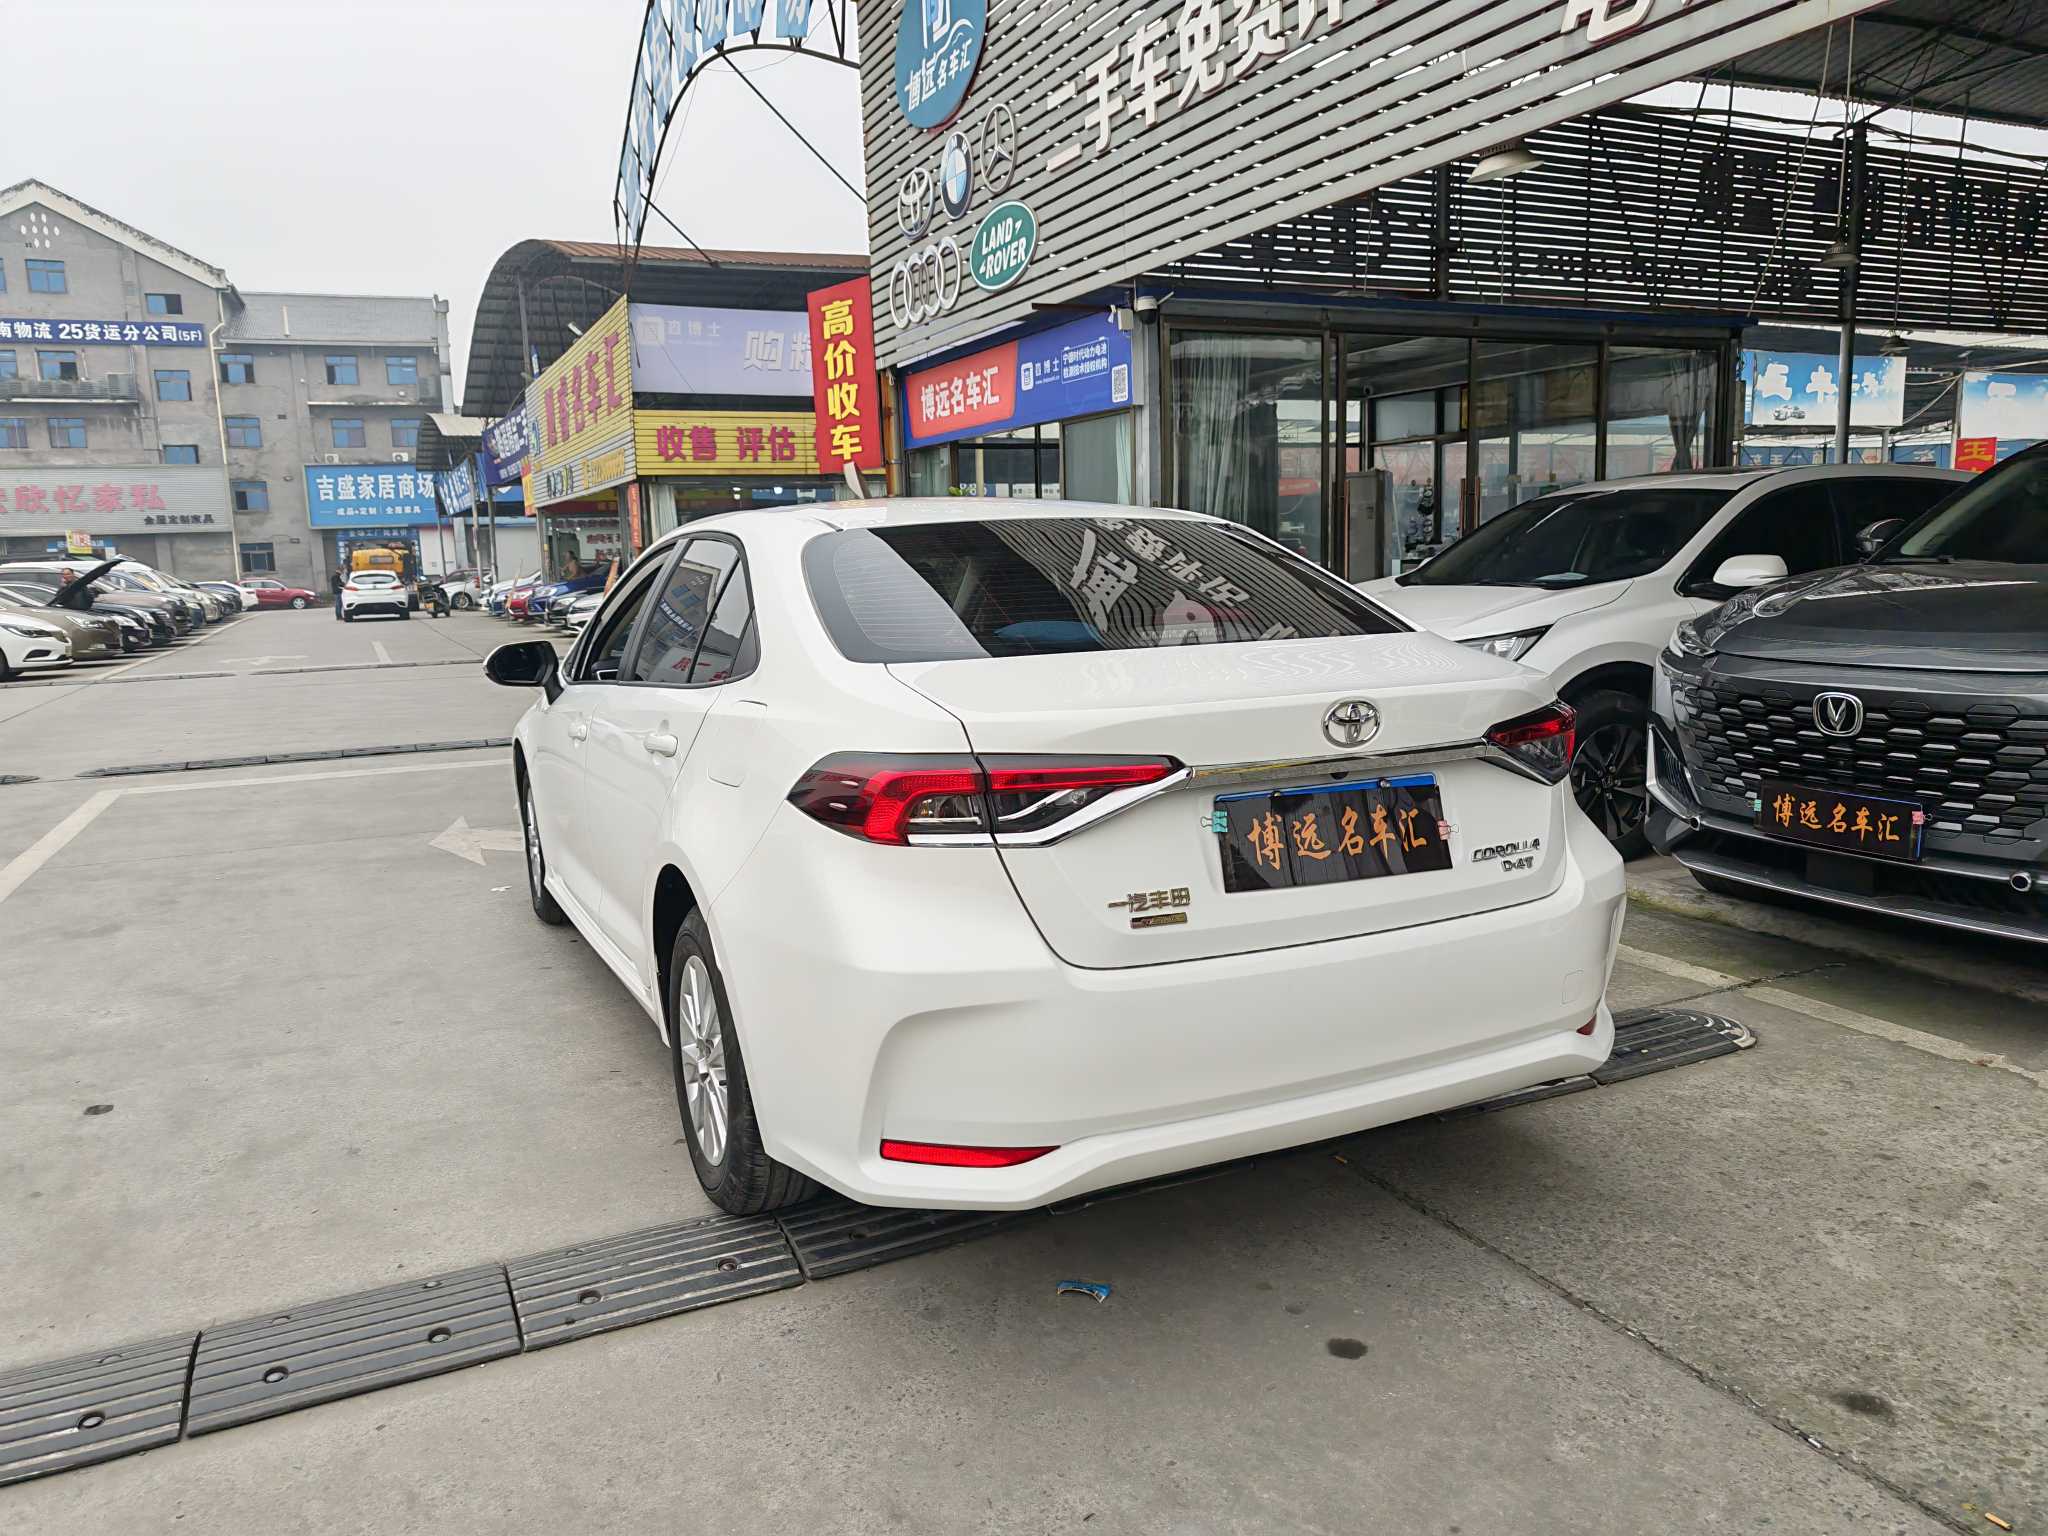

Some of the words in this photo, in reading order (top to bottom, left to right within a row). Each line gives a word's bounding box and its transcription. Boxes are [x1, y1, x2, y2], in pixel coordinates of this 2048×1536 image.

[981, 217, 1013, 256] LAND
[986, 237, 1027, 280] ROVER
[821, 299, 862, 461] 高价收车
[920, 366, 1000, 422] 博远名车汇
[656, 425, 717, 462] 收售
[736, 426, 796, 462] 评估
[316, 473, 435, 500] 吉盛家居商场
[1247, 803, 1428, 870] 博远名车汇
[1773, 793, 1901, 843] 博远名车汇
[1107, 887, 1191, 913] 一汽丰田
